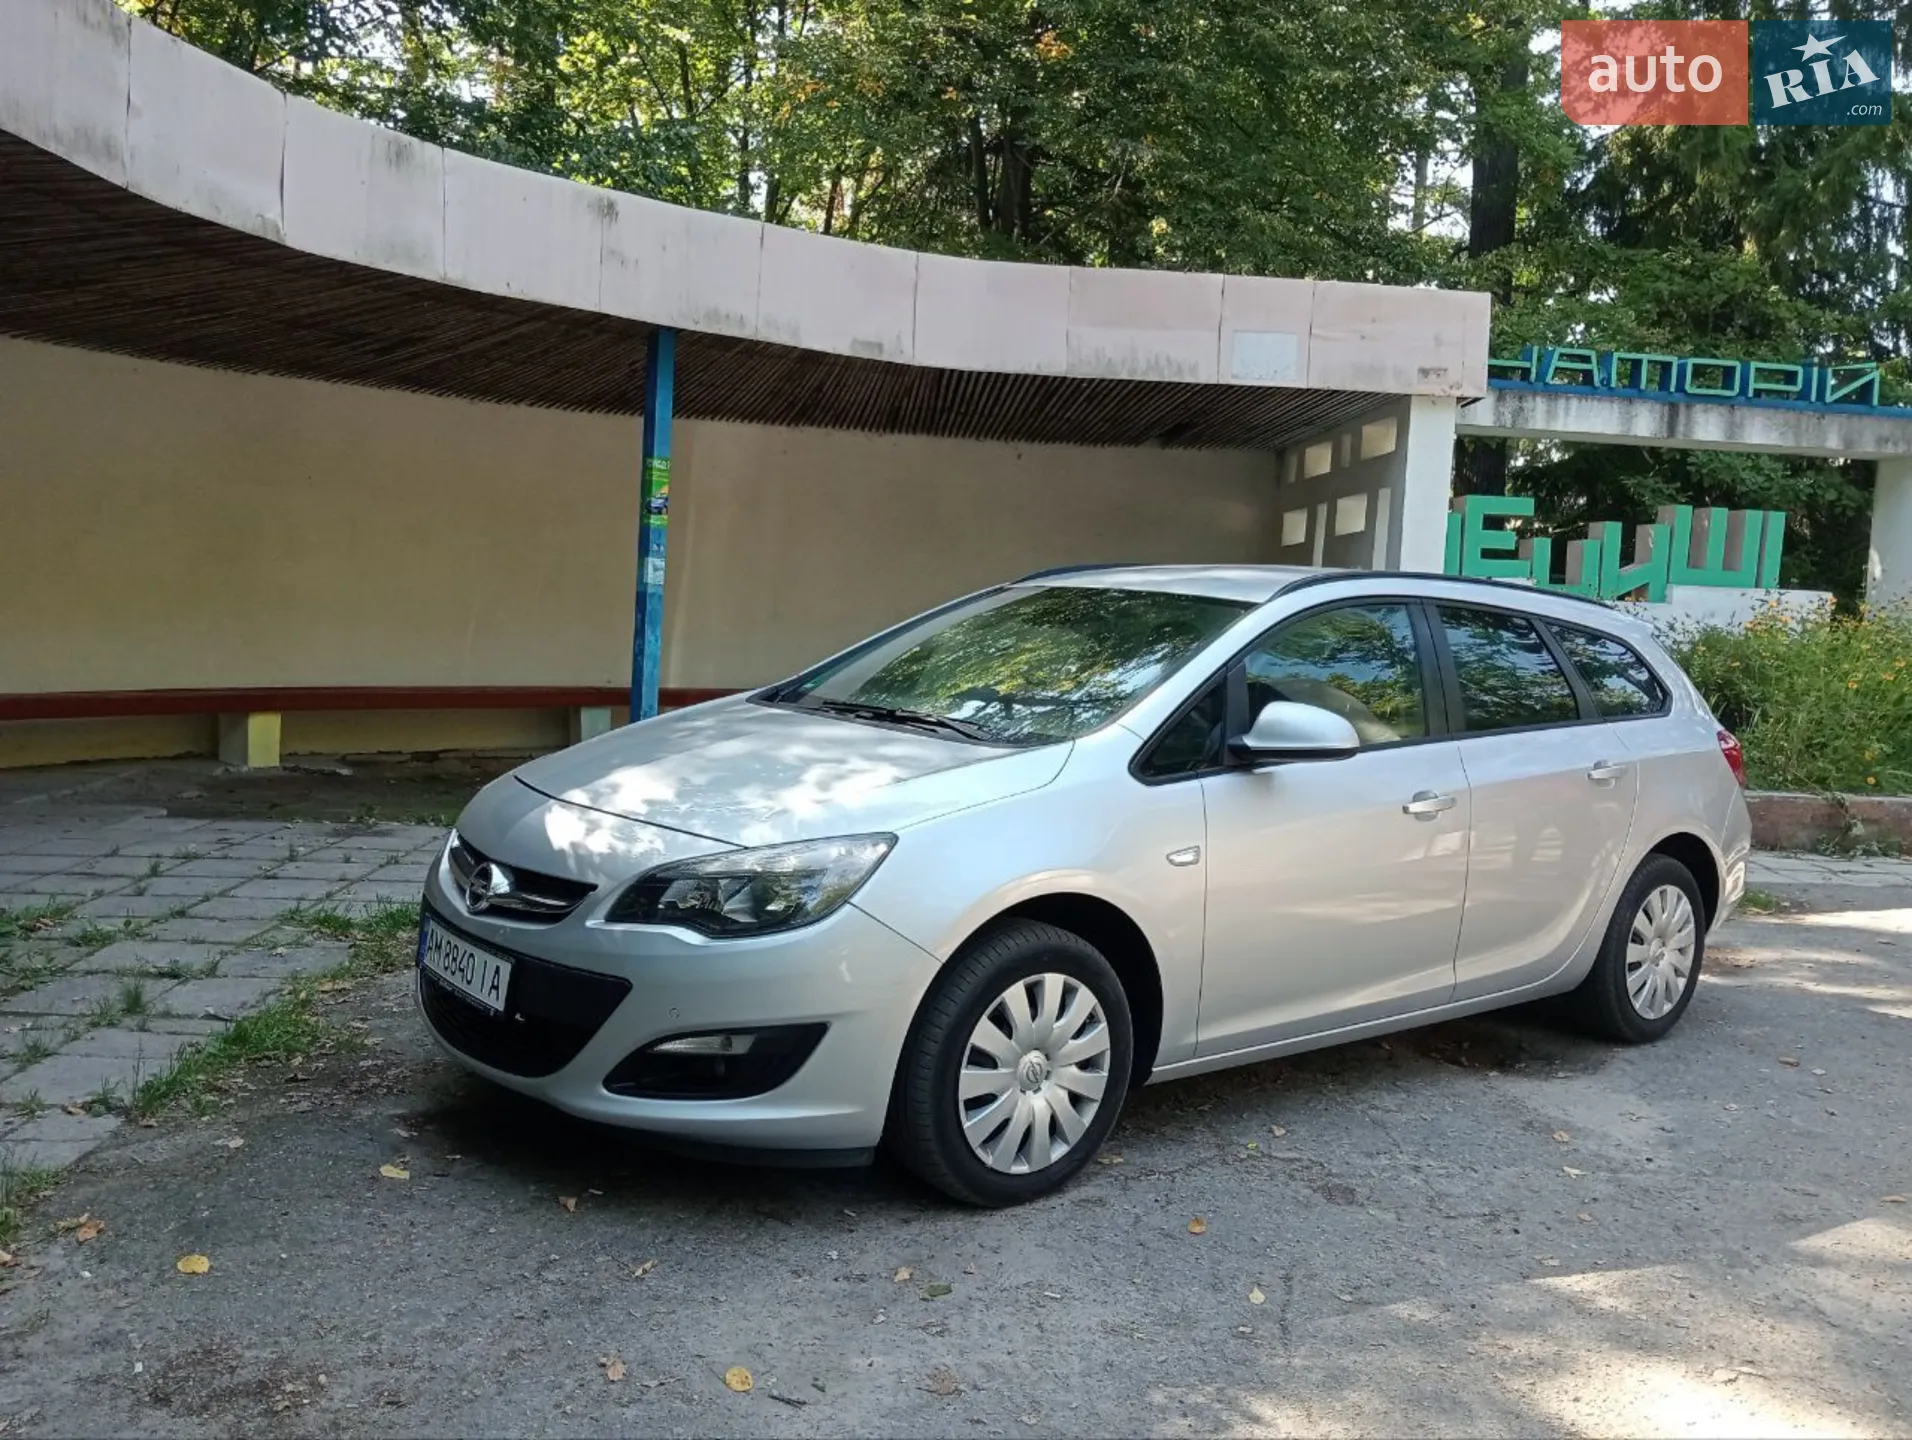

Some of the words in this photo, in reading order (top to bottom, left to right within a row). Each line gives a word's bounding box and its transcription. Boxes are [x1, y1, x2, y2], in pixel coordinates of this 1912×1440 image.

[427, 927, 444, 967] AM
[443, 939, 476, 985] 8840
[480, 960, 501, 1002] IA
